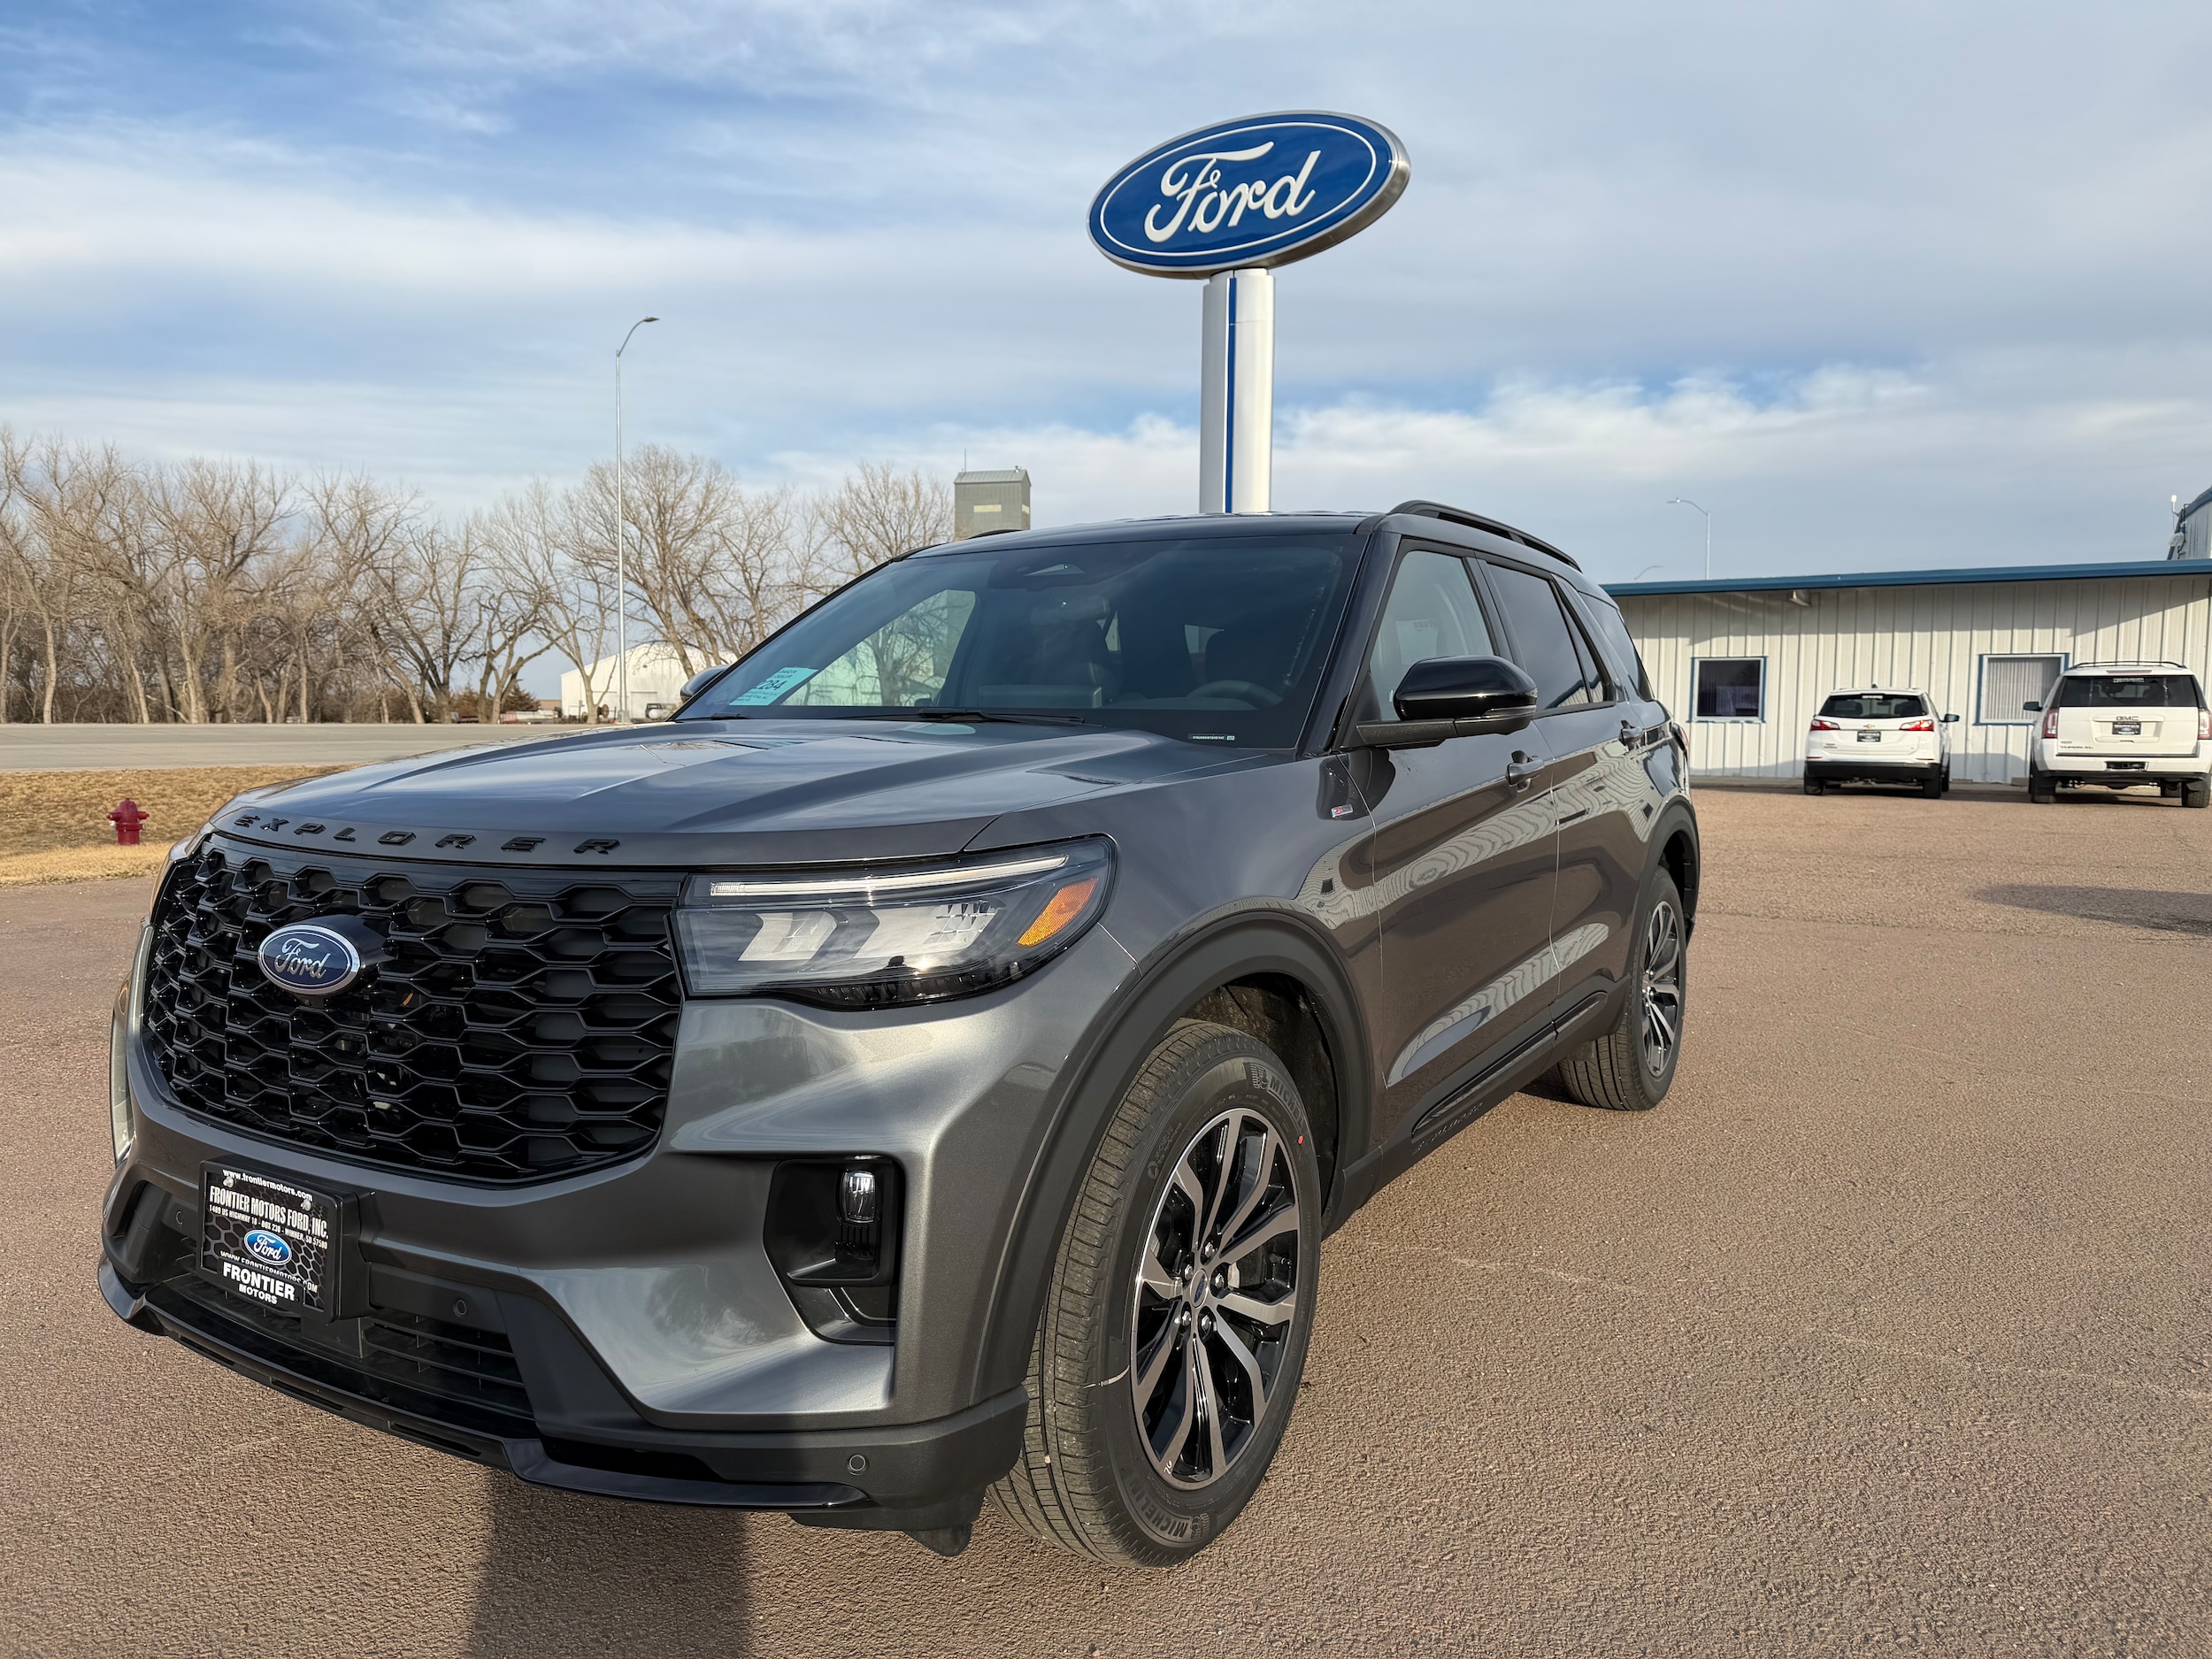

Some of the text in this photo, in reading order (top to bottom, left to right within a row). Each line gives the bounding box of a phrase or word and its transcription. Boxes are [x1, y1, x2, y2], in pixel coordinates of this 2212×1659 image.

[1144, 141, 1321, 243] Ford
[234, 814, 620, 855] EXPLORER
[274, 938, 331, 979] Ford
[222, 1169, 313, 1202] www.frontiermotors.com
[210, 1185, 329, 1240] FRONTIER MOTORS FORD, INC.
[221, 1208, 229, 1217] US
[229, 1210, 251, 1224] HIGHWAY
[261, 1219, 271, 1231] BOX
[305, 1235, 312, 1244] SD
[312, 1237, 328, 1250] 57580
[254, 1234, 283, 1261] Ford
[223, 1262, 296, 1302] FRONTIER
[238, 1283, 278, 1305] MOTORS
[1130, 1479, 1188, 1538] MICHELIN
